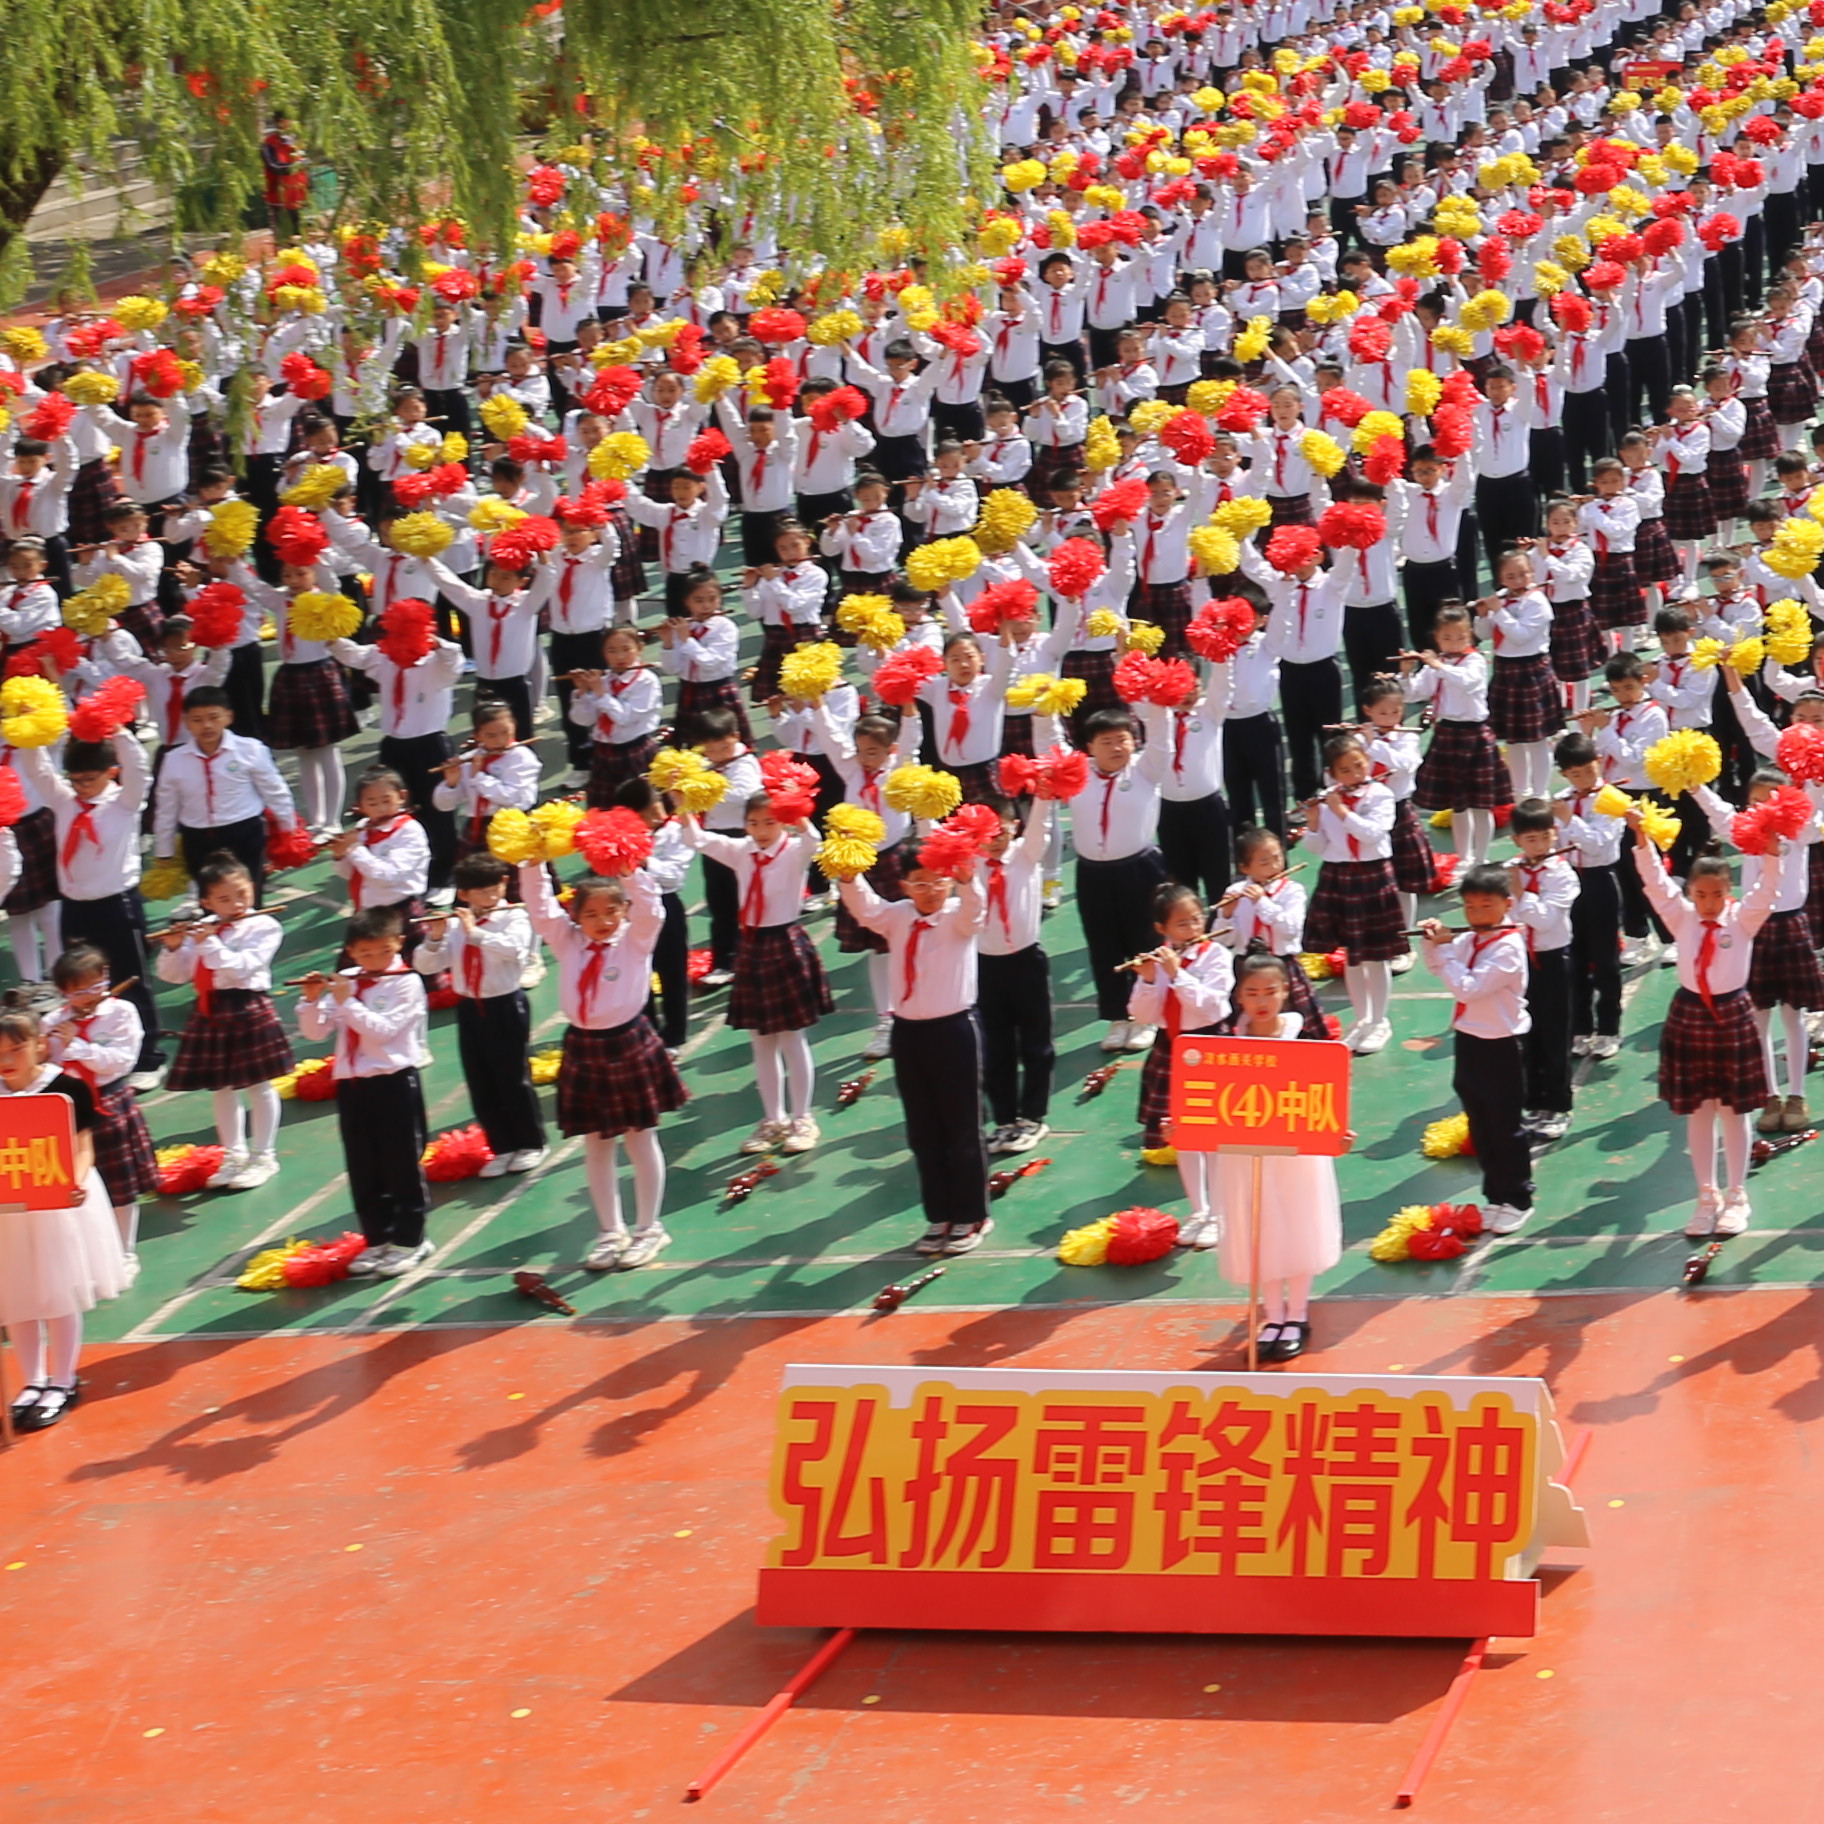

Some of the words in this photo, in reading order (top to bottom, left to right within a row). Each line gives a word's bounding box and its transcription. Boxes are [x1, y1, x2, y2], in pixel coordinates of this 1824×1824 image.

[1179, 1080, 1341, 1133] 三(4)中队
[780, 1395, 1525, 1579] 弘扬雷锋精神
